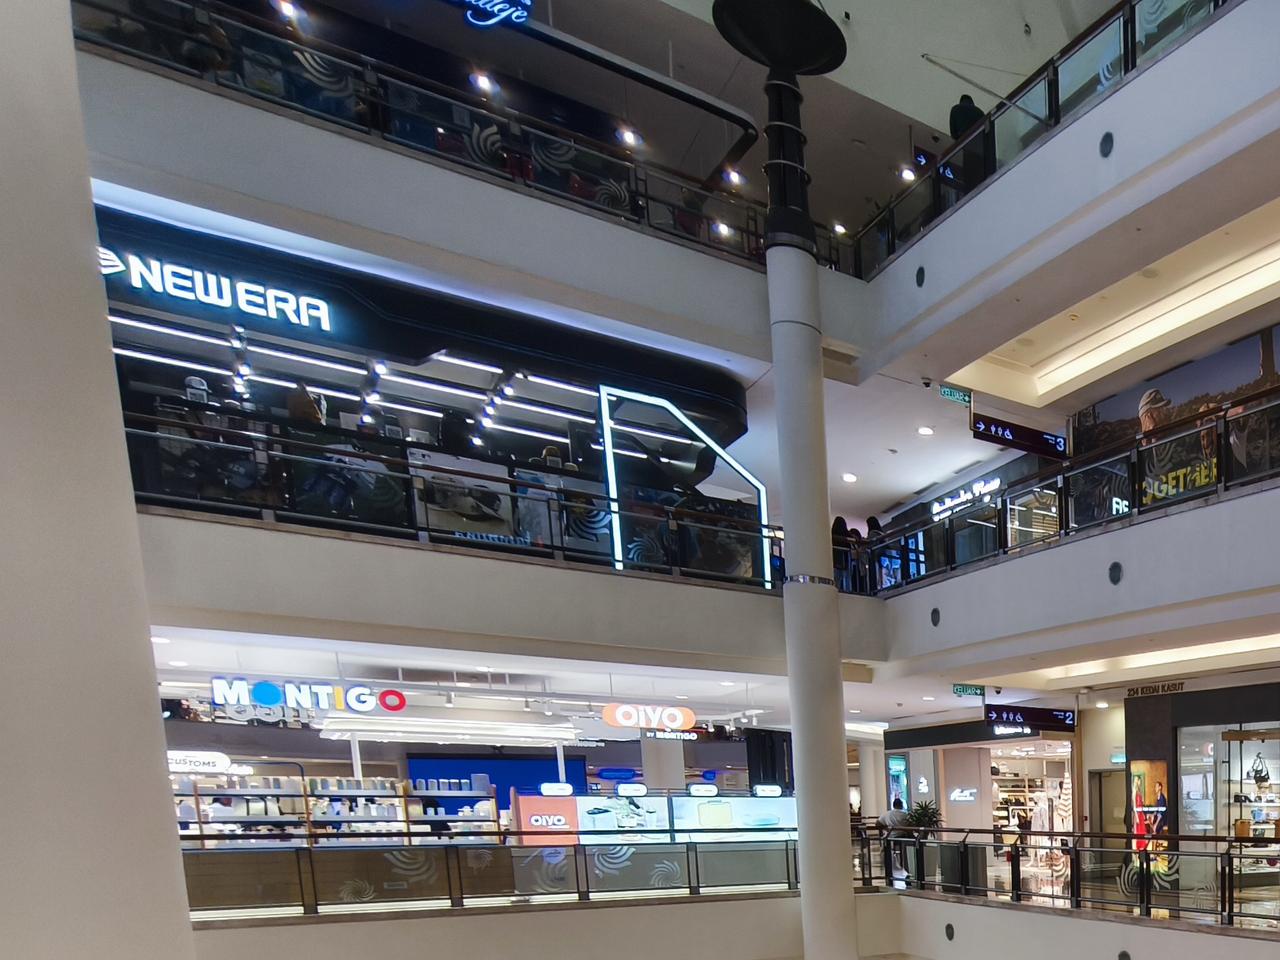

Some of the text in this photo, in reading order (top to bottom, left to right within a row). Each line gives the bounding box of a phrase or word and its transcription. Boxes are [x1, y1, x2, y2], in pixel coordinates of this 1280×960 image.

[128, 254, 331, 331] NEW ERA
[1056, 437, 1065, 451] 3
[212, 677, 407, 713] MONTIGO
[1065, 711, 1073, 724] 2
